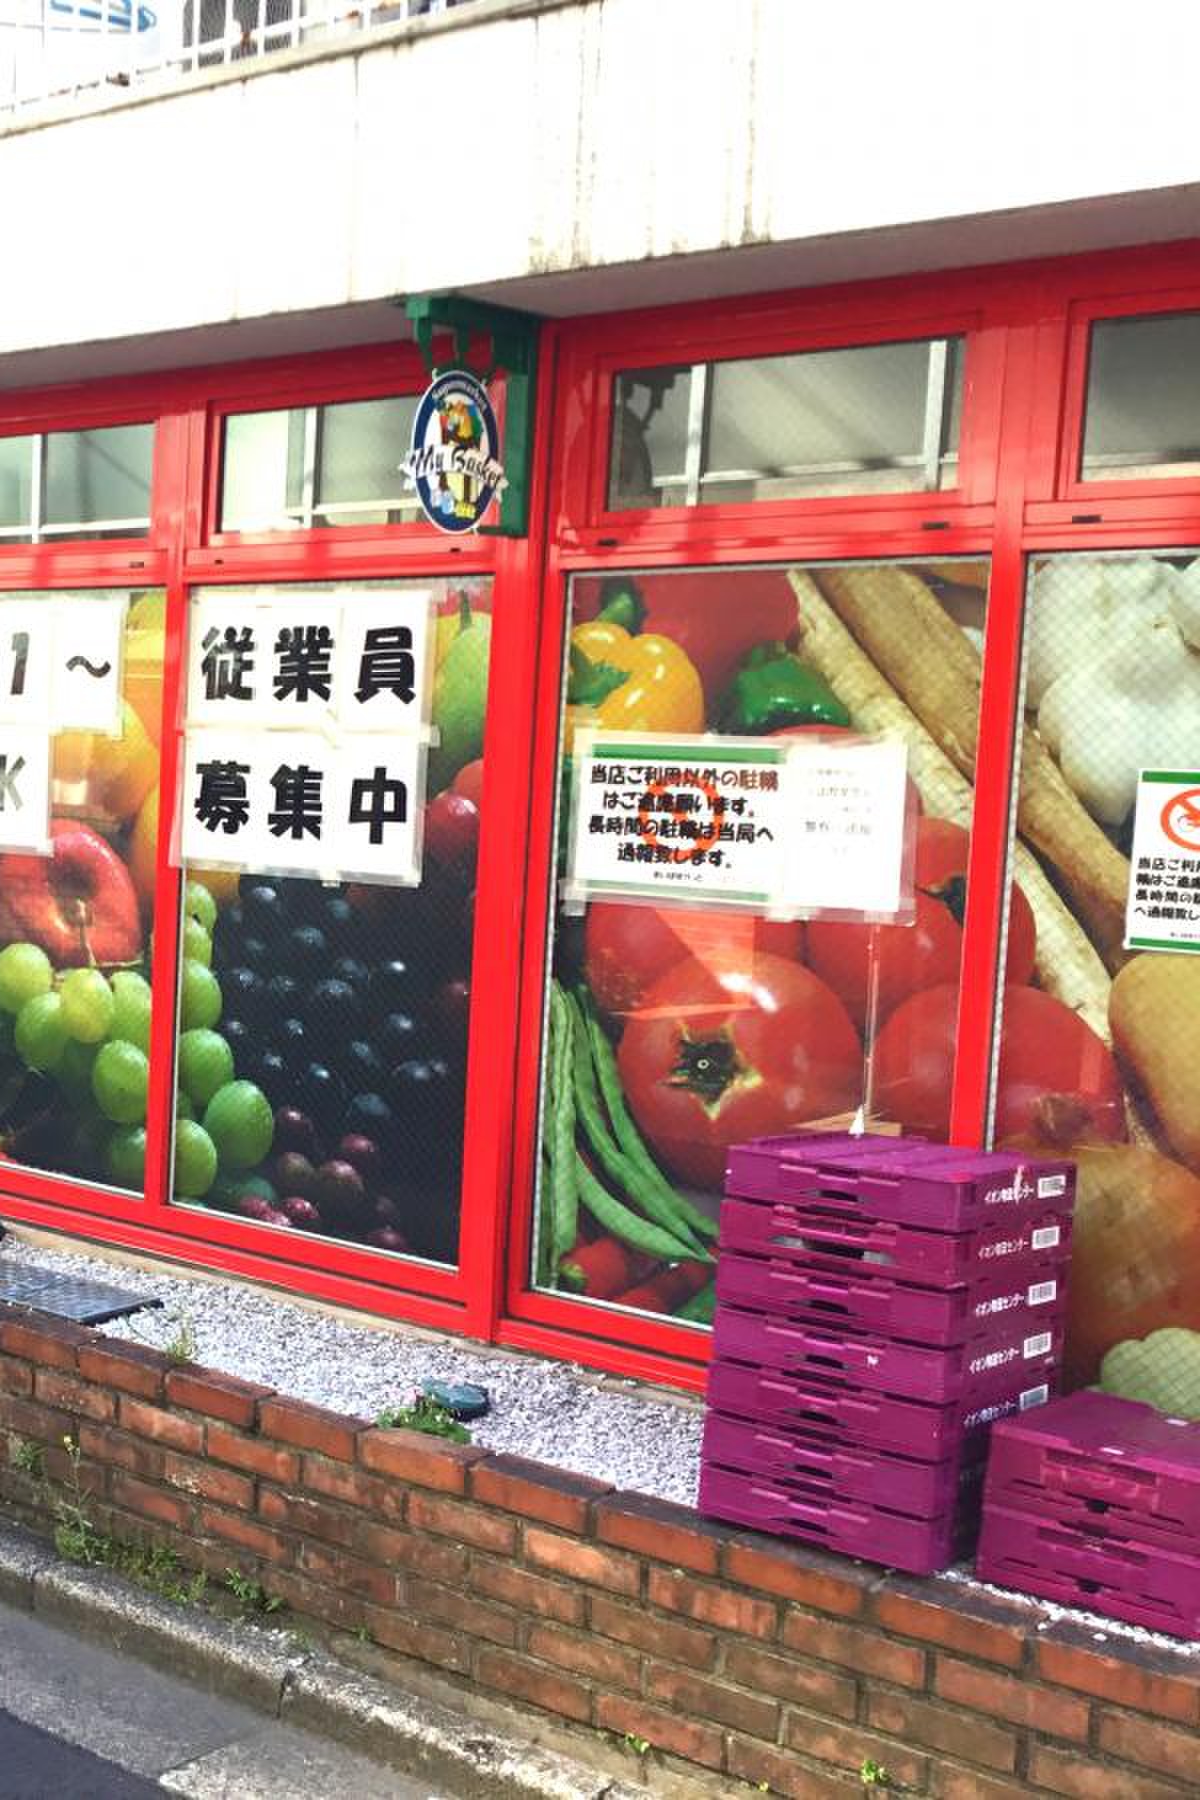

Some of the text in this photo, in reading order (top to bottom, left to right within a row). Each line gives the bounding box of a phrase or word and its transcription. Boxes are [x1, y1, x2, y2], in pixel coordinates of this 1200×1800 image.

[200, 626, 416, 704] 従業員
[194, 760, 408, 844] 募集中
